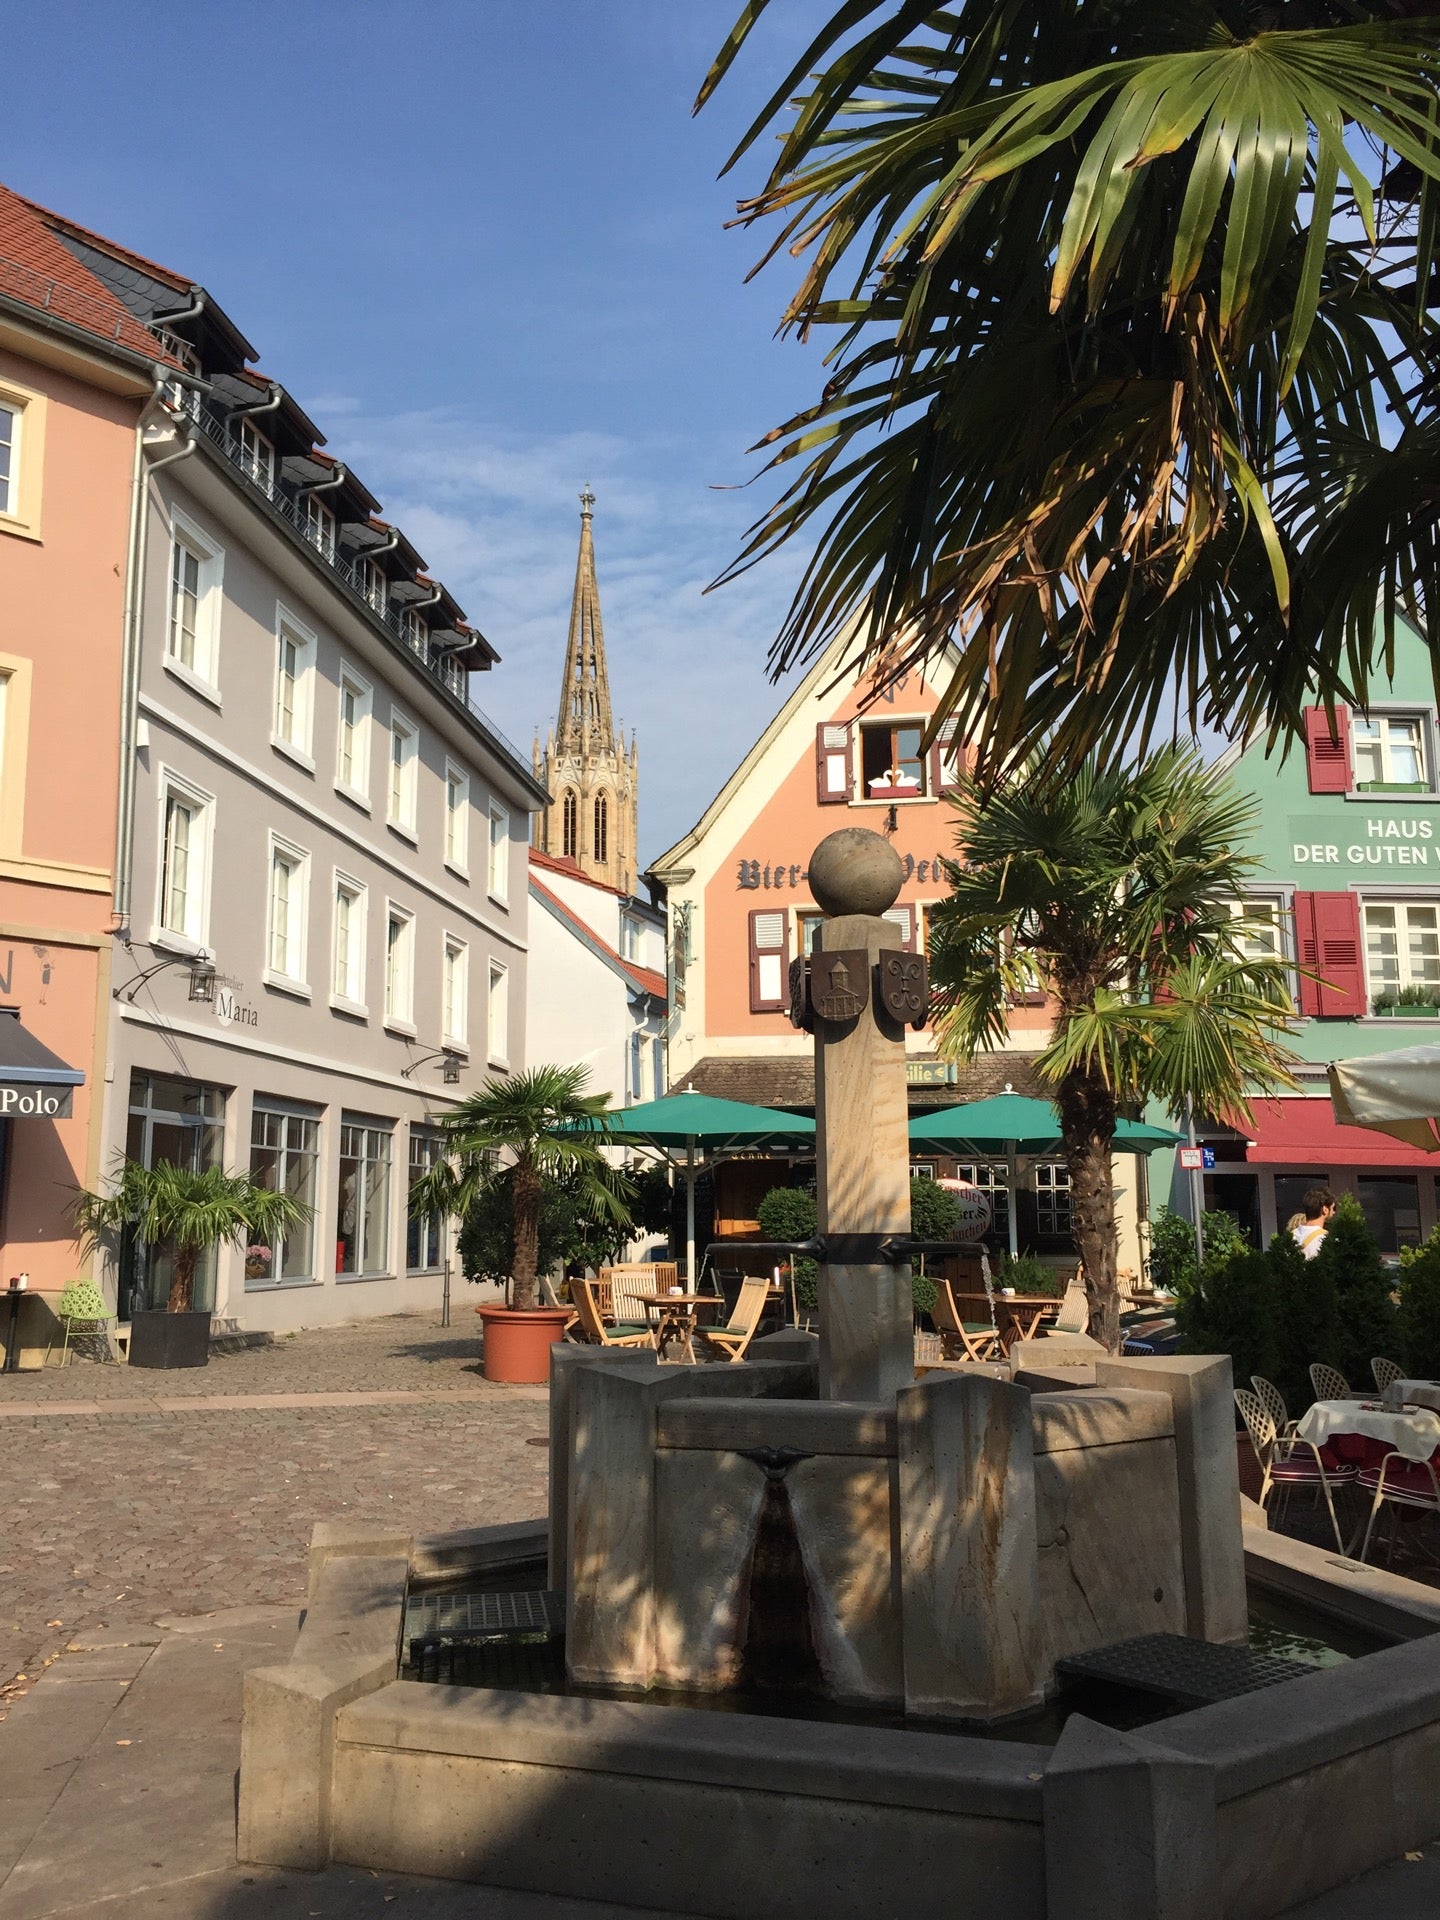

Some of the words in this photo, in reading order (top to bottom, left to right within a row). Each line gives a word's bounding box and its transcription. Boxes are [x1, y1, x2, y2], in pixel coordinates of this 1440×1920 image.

[1367, 819, 1433, 839] HAUS
[1293, 844, 1340, 863] DER
[1346, 845, 1428, 865] GUTEN
[217, 992, 258, 1027] Maria
[0, 1088, 59, 1114] Polo
